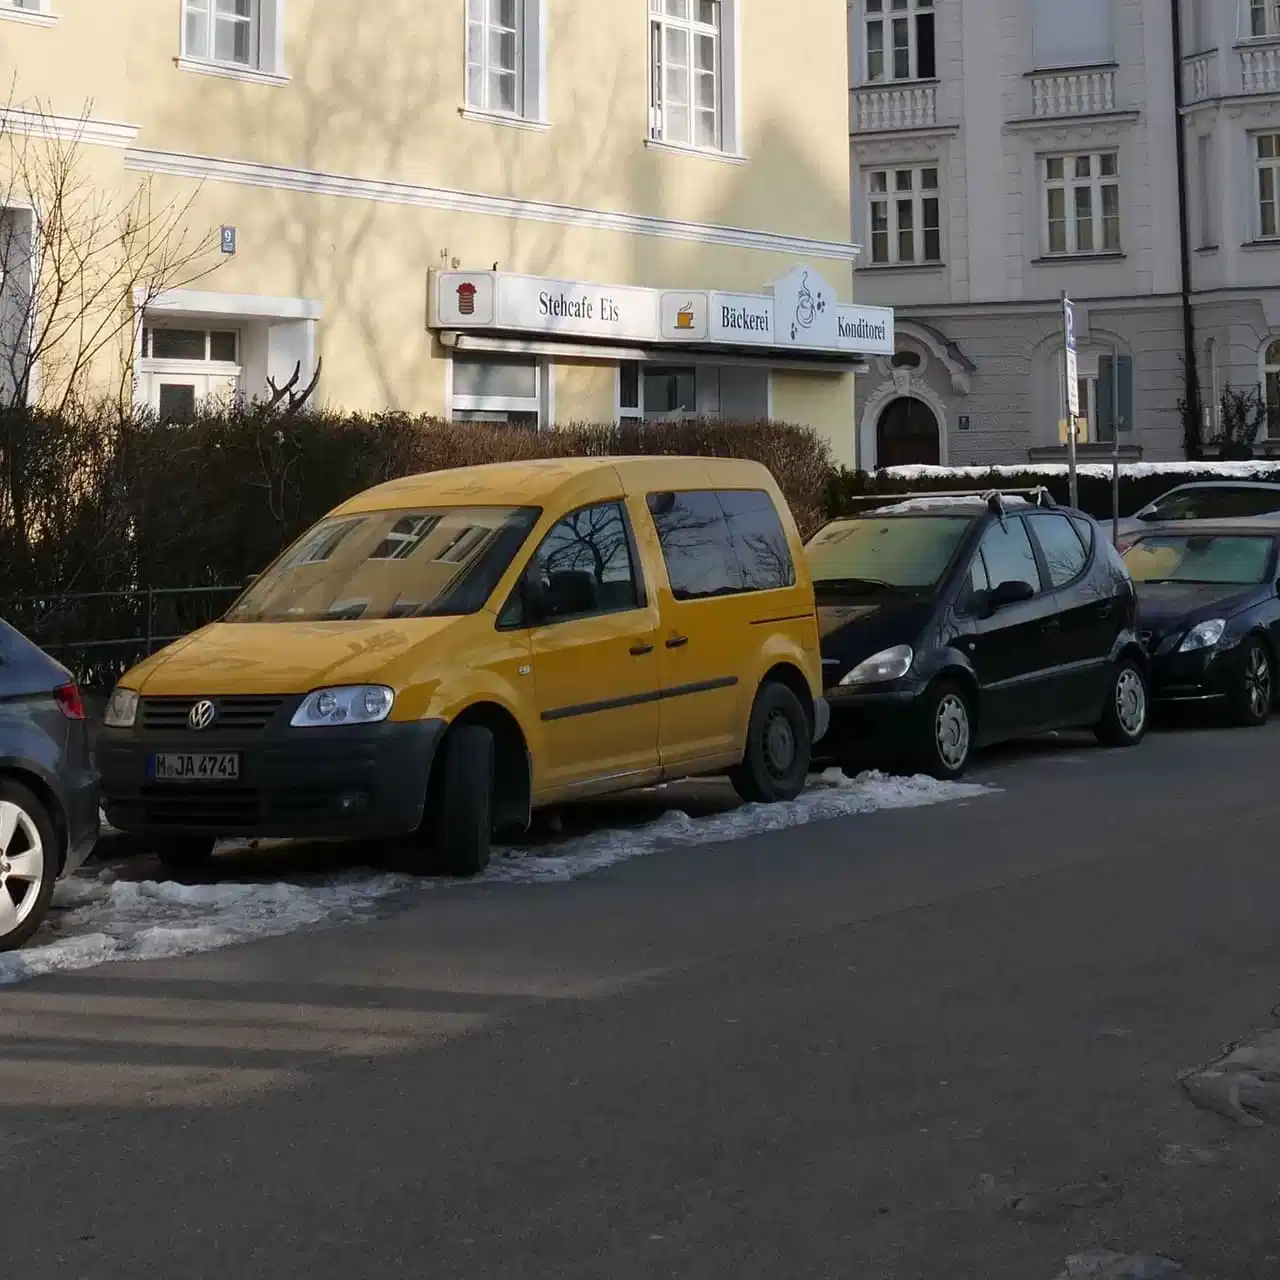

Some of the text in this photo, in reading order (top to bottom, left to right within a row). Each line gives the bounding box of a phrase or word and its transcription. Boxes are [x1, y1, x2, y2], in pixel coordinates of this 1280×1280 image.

[224, 229, 232, 243] 9
[539, 291, 620, 322] Stehcafe Eis
[721, 305, 769, 331] Bäckerei
[837, 316, 886, 341] Konditorei
[198, 756, 237, 776] 4741
